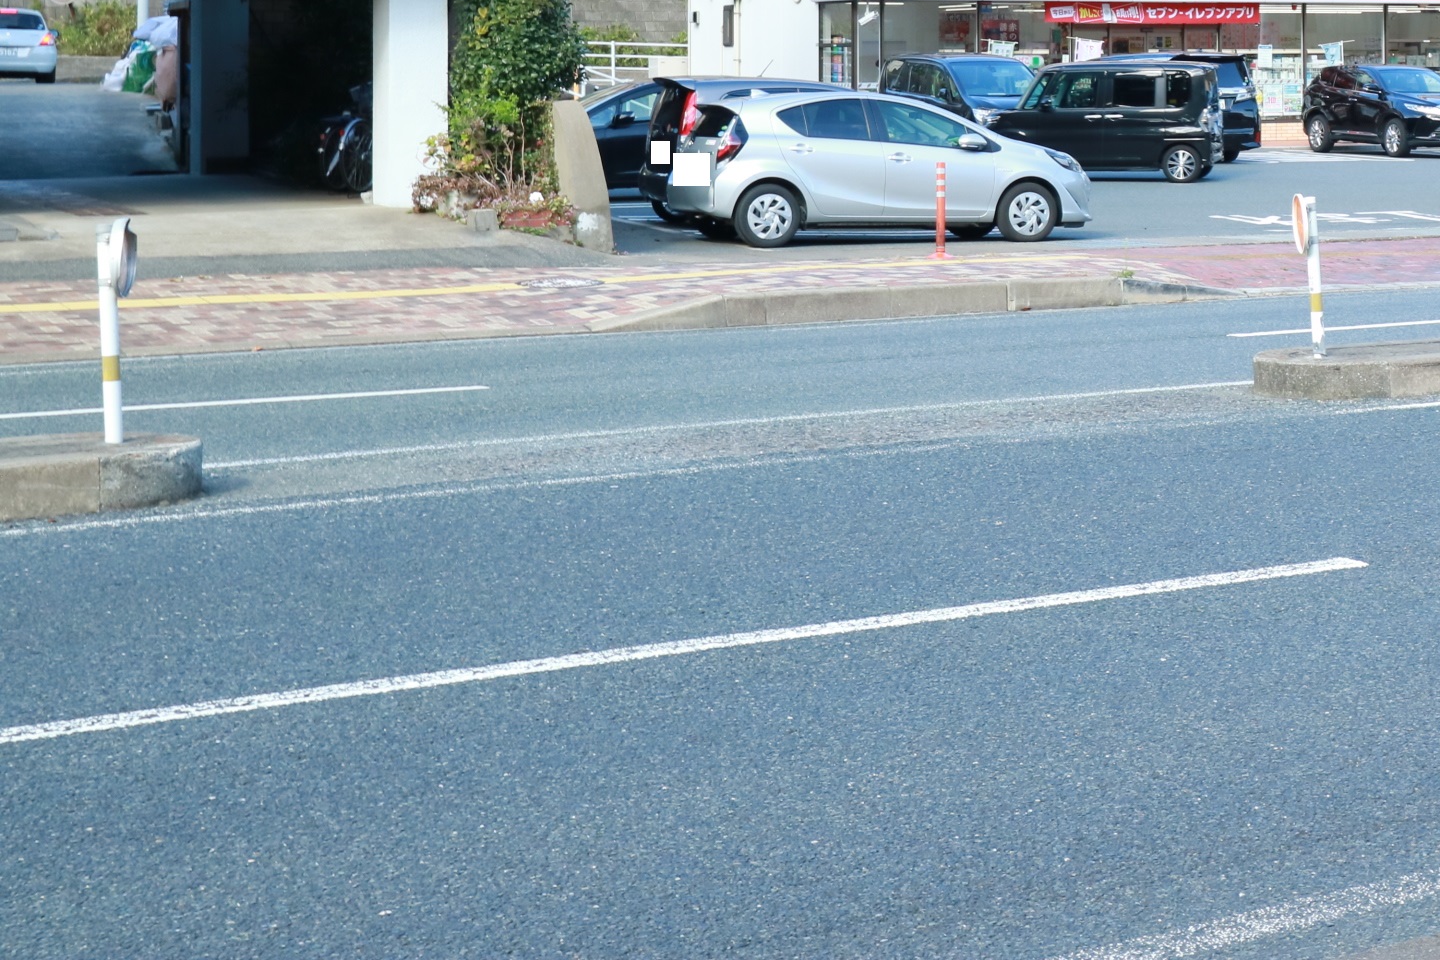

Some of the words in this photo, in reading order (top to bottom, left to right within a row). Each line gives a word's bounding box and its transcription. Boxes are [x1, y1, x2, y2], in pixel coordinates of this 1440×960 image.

[1146, 6, 1255, 19] セブン-イレブンアプリ
